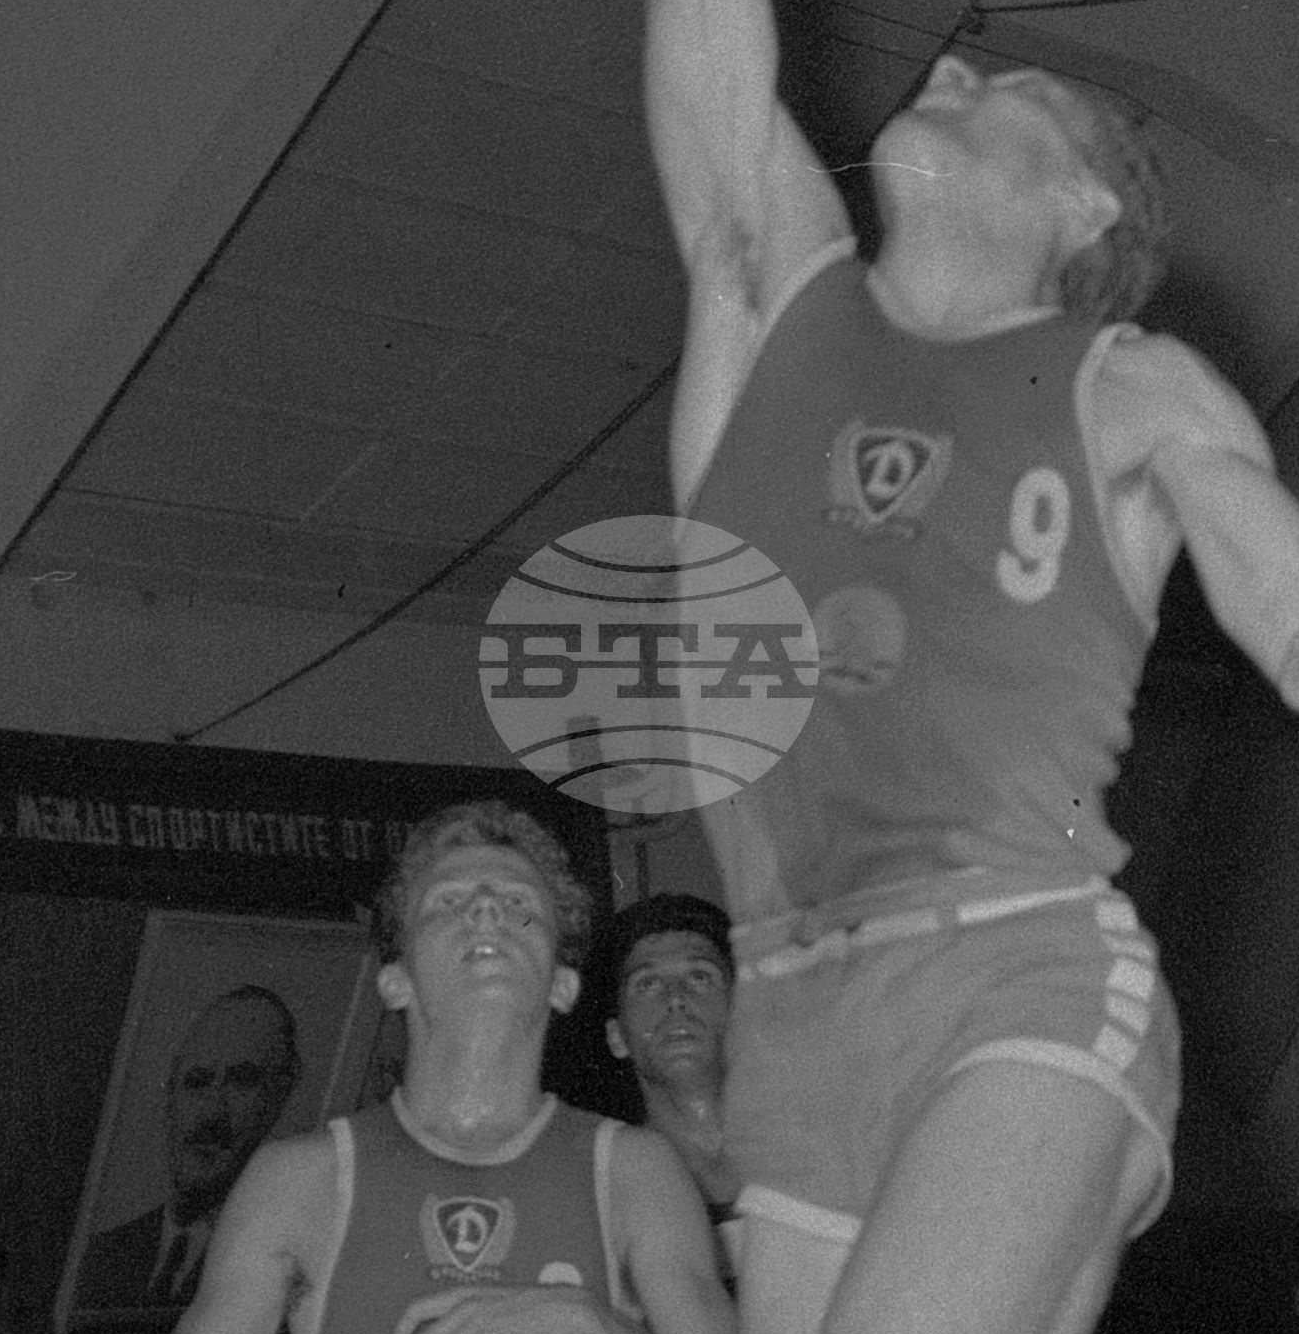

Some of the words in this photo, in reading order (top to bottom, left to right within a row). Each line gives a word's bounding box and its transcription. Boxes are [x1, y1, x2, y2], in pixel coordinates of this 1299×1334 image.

[997, 468, 1070, 603] 9
[15, 794, 121, 848] МЕЖДУ
[128, 803, 330, 860] СПОРТИСТИТЕ
[342, 818, 372, 861] ОТ
